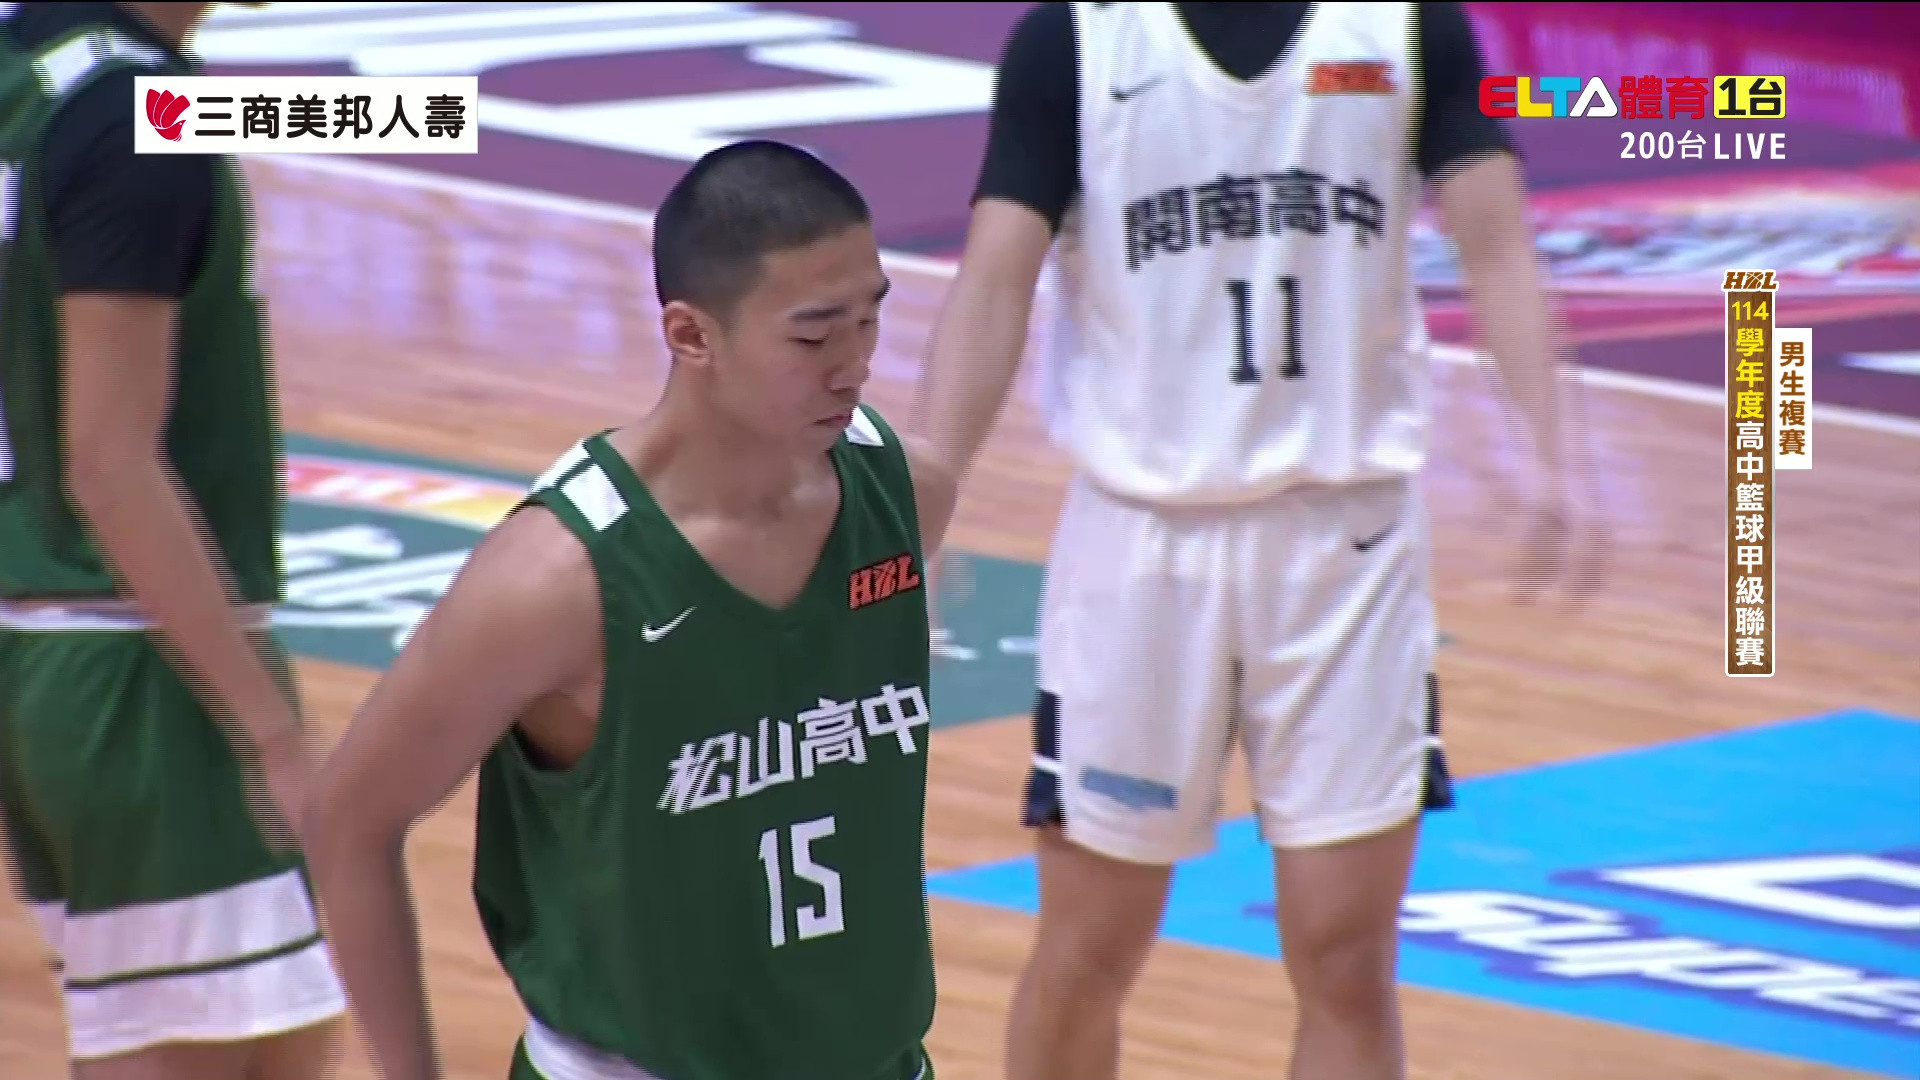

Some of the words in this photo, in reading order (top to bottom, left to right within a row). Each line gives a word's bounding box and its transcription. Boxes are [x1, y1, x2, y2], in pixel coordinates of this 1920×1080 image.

[1224, 275, 1306, 384] 11
[656, 683, 930, 815] 松山高中
[758, 815, 845, 949] 15
